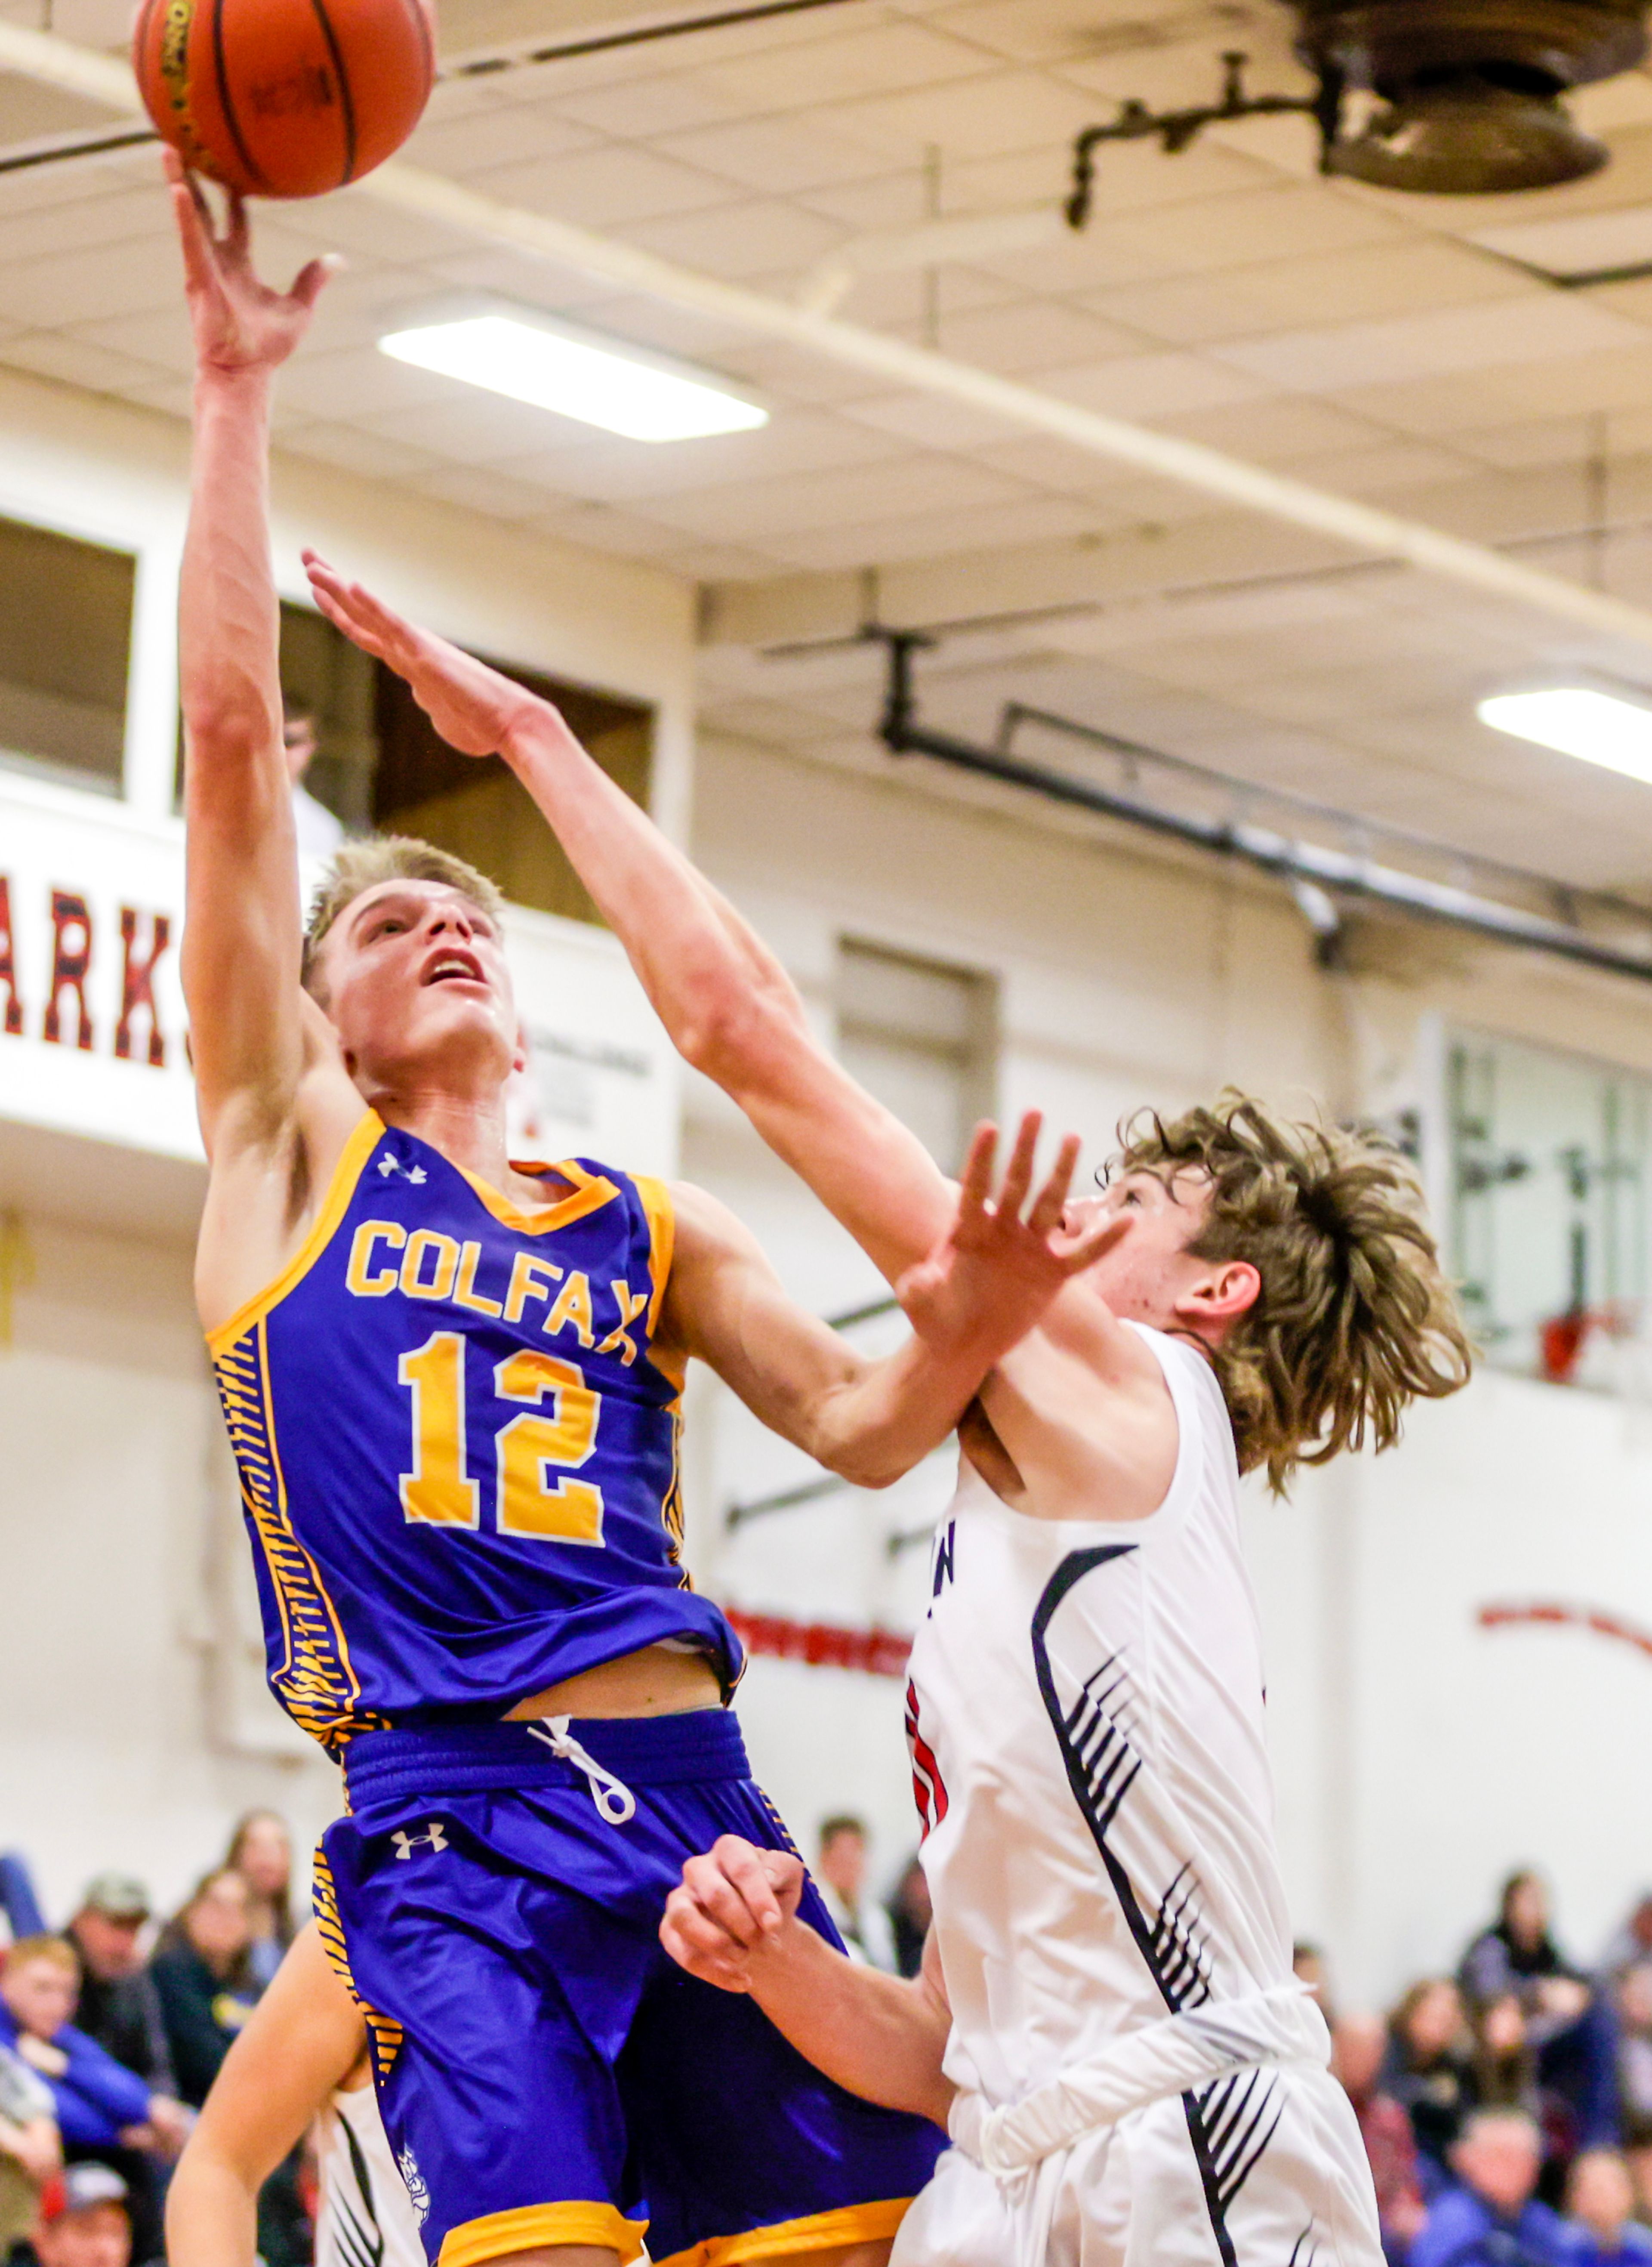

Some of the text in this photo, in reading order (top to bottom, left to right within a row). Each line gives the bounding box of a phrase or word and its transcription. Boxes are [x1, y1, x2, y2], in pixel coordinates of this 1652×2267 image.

[0, 875, 193, 1067] ARK
[345, 1220, 648, 1367] COLFAX
[398, 1331, 605, 1548] 12
